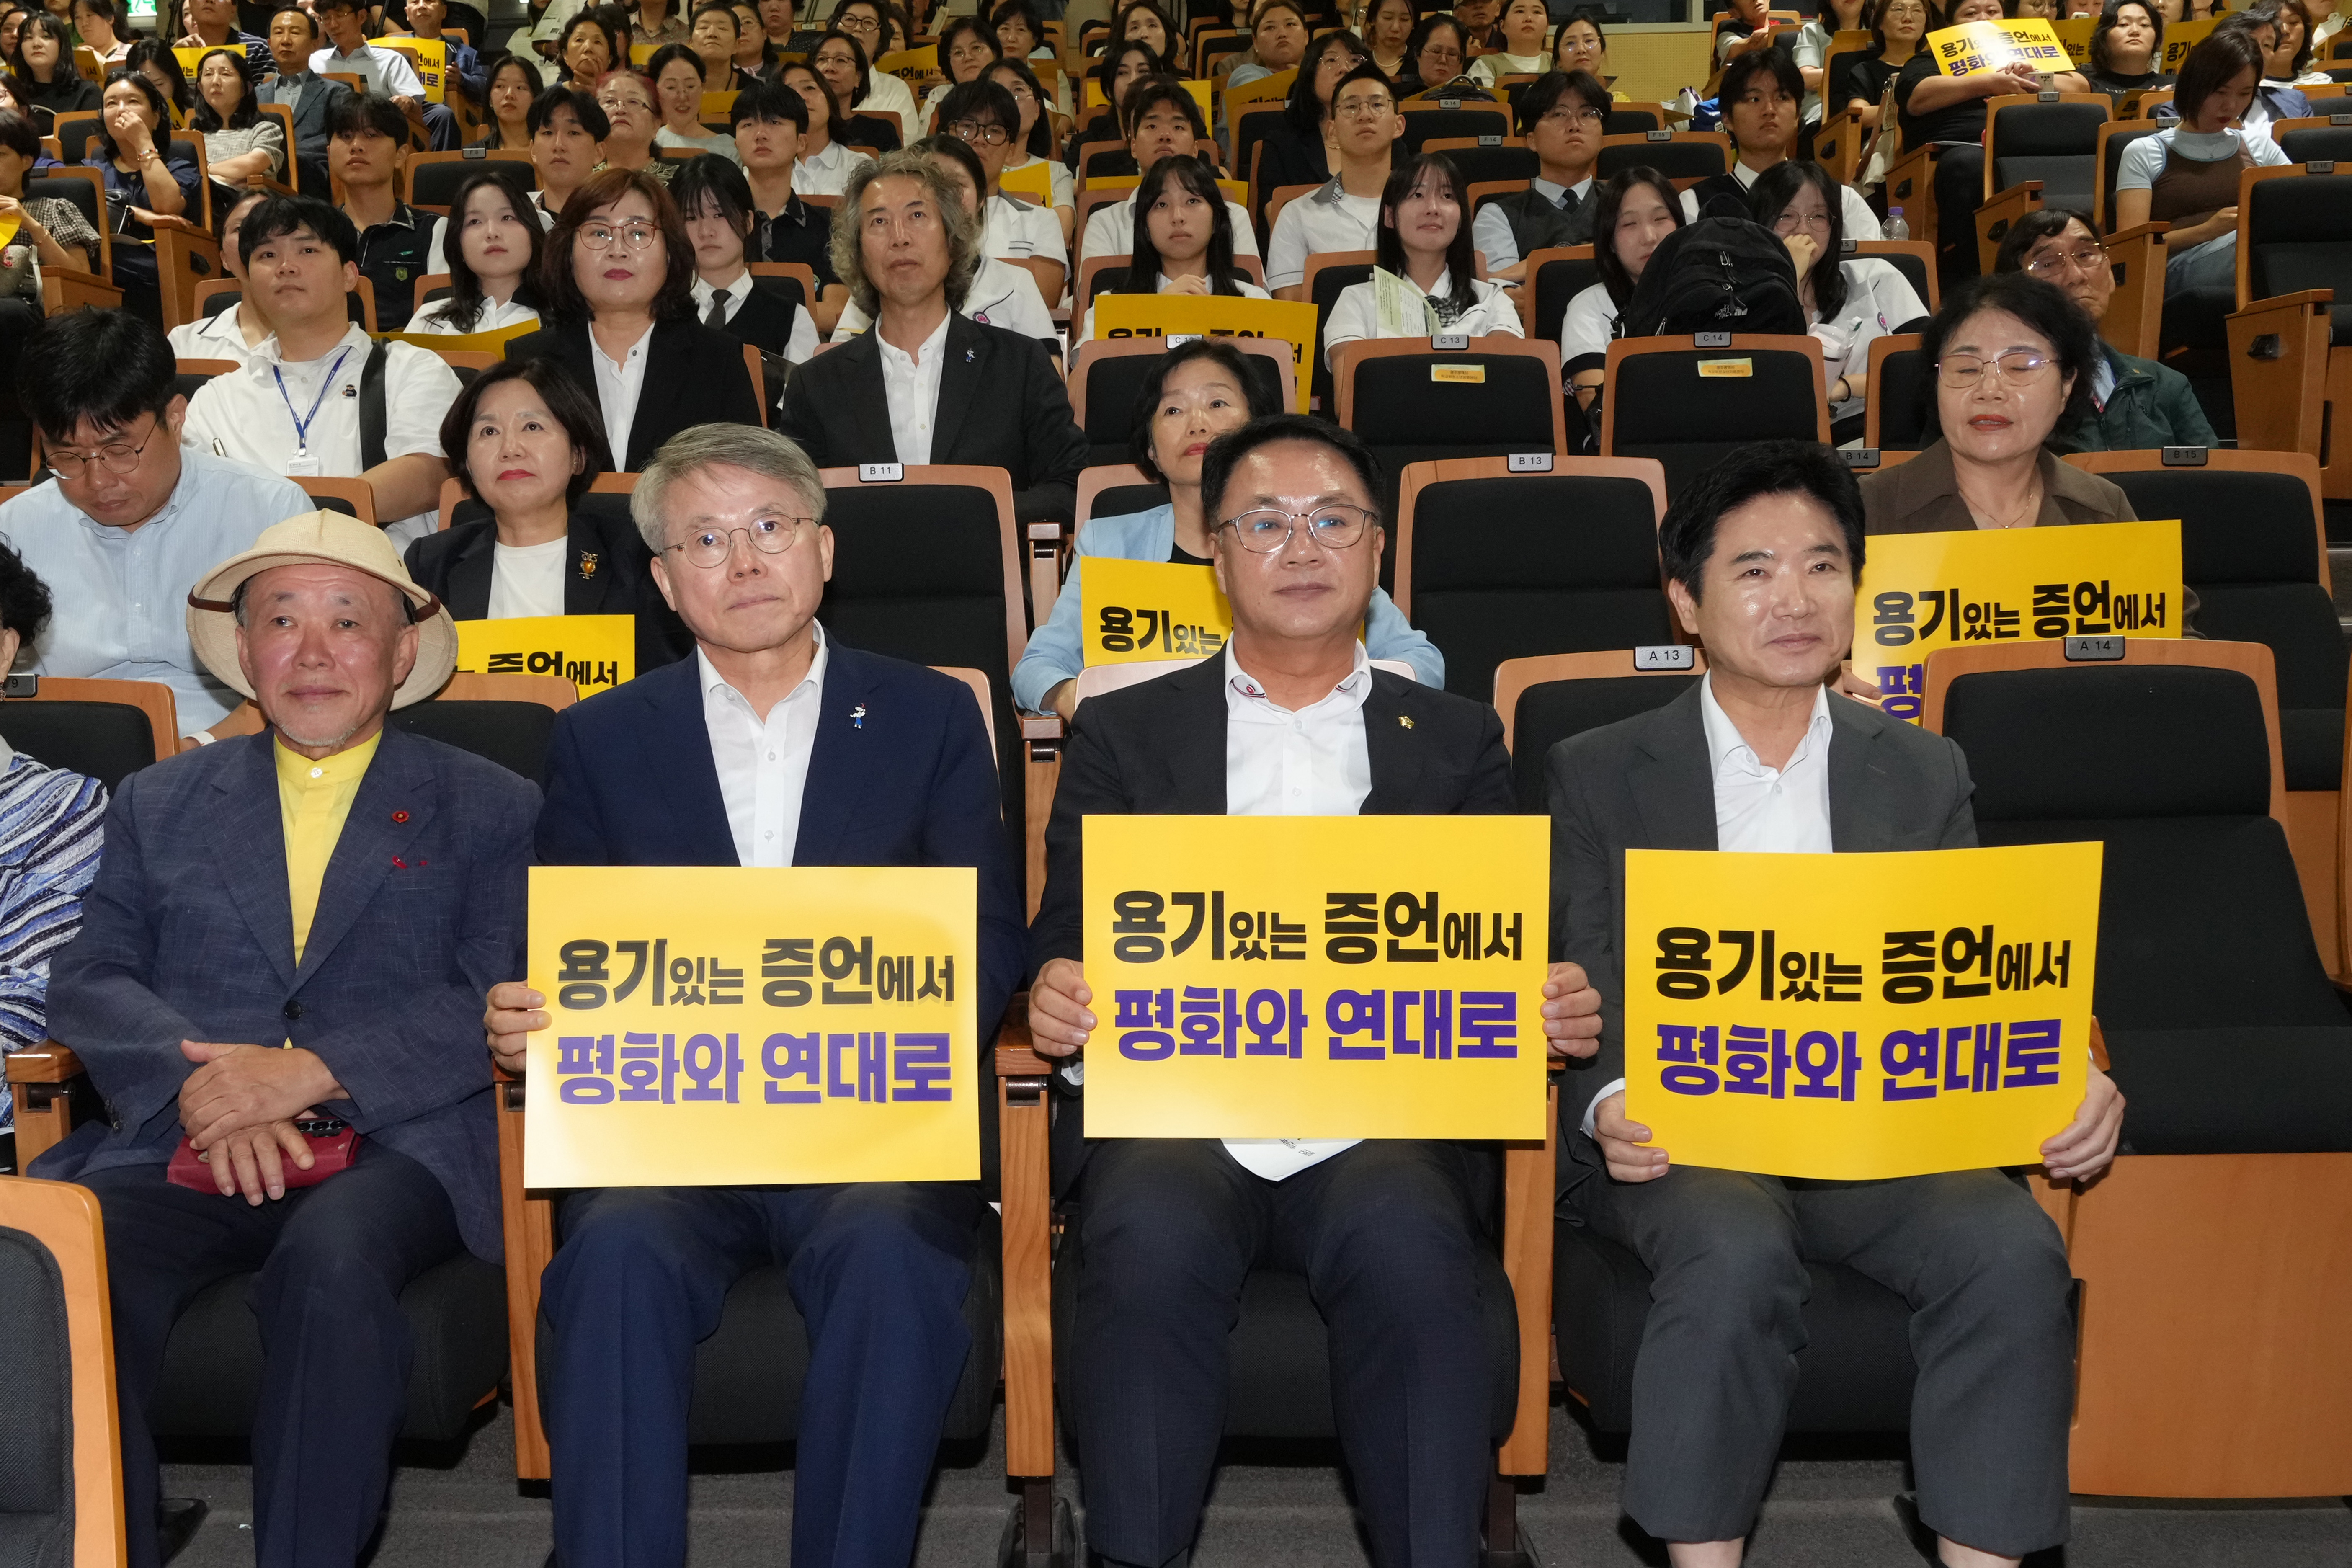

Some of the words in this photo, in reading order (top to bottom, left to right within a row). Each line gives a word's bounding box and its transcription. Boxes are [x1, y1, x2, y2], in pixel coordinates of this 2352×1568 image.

[1940, 37, 1995, 58] 용기있
[1997, 31, 2052, 45] 증언에서
[2006, 46, 2061, 60] 연대로
[1100, 606, 1222, 655] 용기있는
[1873, 588, 2020, 647] 용기있는
[2032, 580, 2166, 638] 증언에서
[2080, 641, 2089, 650] A
[2095, 640, 2110, 650] 14
[12, 679, 18, 688] 9
[1649, 651, 1658, 661] A
[1665, 650, 1679, 660] 13
[1112, 890, 1306, 963] 용기있는
[1324, 891, 1522, 964] 증언에서
[557, 938, 744, 1010] 용기있는
[761, 936, 954, 1007] 증언에서
[1655, 926, 1862, 1002] 용기있는
[1881, 925, 2071, 1004] 증언에서
[1114, 985, 1308, 1061] 평화와
[1325, 989, 1518, 1060] 연대로
[556, 1031, 744, 1105] 평화와
[761, 1031, 952, 1104] 연대로
[1656, 1024, 1862, 1102] 평화와
[1880, 1019, 2061, 1102] 연대로
